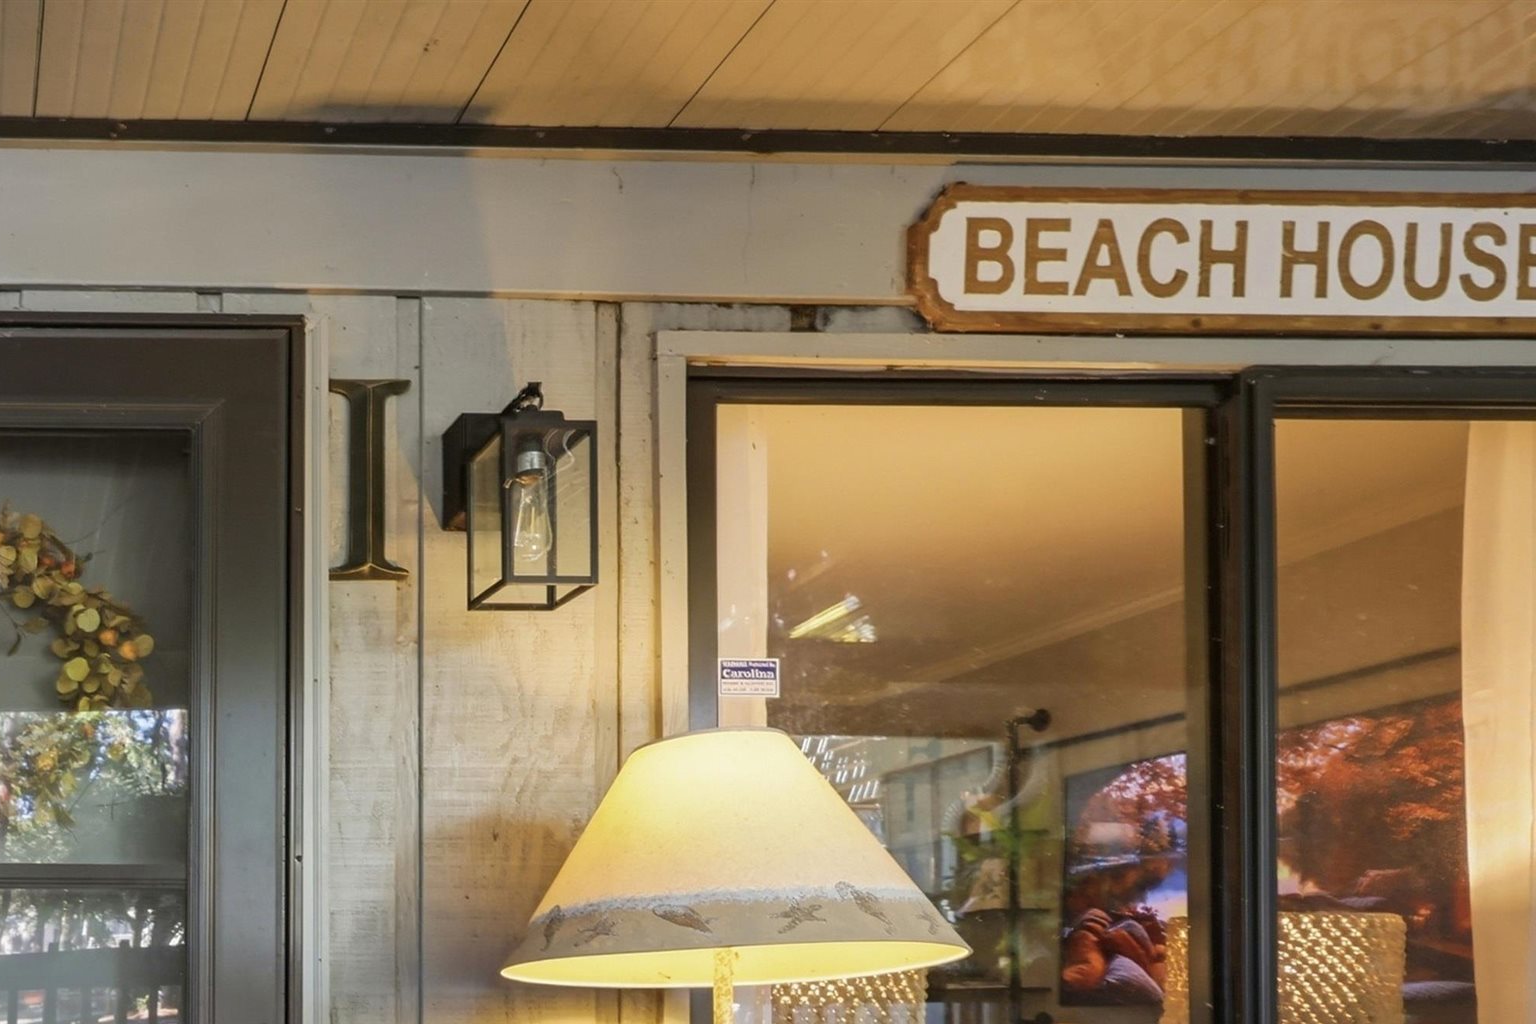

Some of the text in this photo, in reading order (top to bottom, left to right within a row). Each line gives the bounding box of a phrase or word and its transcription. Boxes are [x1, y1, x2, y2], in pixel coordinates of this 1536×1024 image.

[964, 216, 1536, 301] BEACH HOUSE
[722, 668, 775, 678] Carolina
